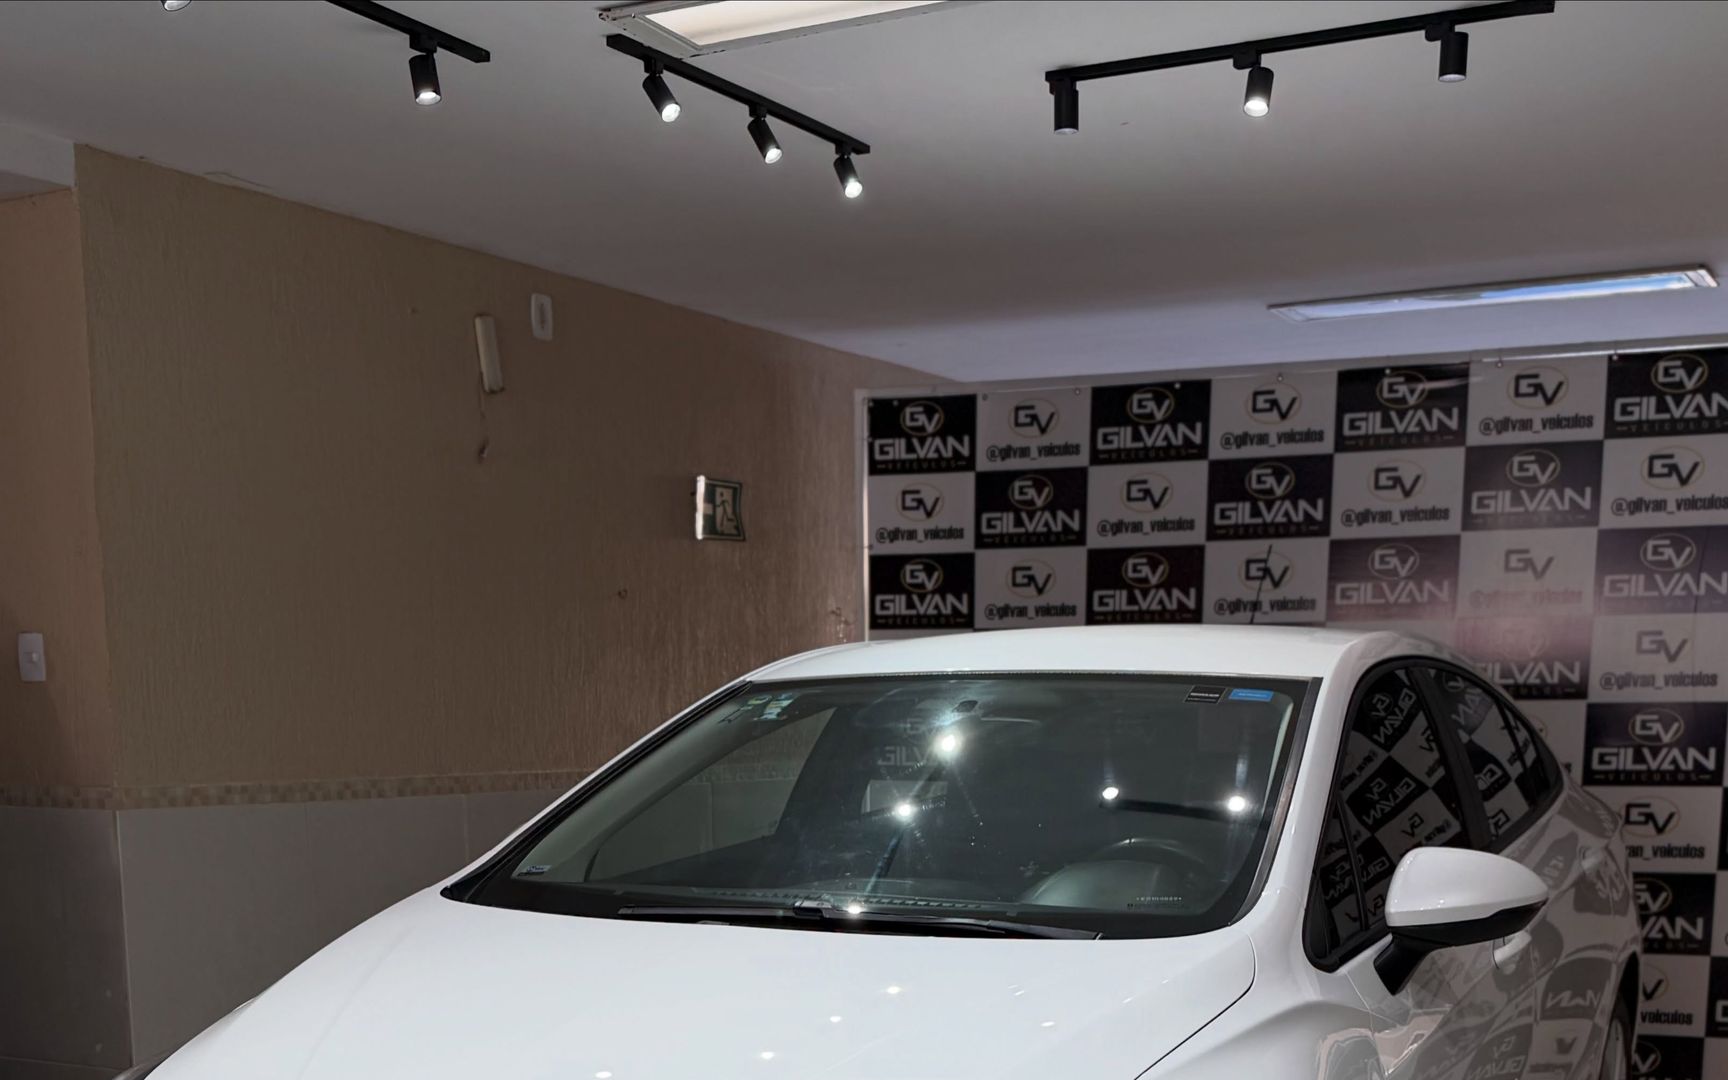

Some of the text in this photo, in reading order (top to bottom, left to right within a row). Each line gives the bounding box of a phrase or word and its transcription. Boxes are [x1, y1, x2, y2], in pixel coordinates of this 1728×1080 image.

[1514, 373, 1565, 406] GV
[1658, 361, 1705, 390] GV
[1252, 389, 1298, 420] GV
[1382, 377, 1424, 404] GV
[906, 406, 940, 432] GV
[1014, 404, 1056, 434] GV
[1132, 393, 1171, 421] GV
[1096, 421, 1203, 449] GILVAN
[1342, 406, 1459, 437] GILVAN
[874, 435, 970, 460] GILVAN
[1251, 468, 1291, 497] GV
[1374, 466, 1422, 498] GV
[1512, 455, 1556, 485] GV
[1648, 454, 1699, 486] GV
[901, 489, 941, 518] GV
[1014, 480, 1050, 507] GV
[1126, 479, 1170, 510] GV
[1471, 486, 1592, 515] GILVAN
[980, 509, 1081, 534] GILVAN
[1213, 498, 1324, 526] GILVAN
[1374, 550, 1415, 577] GV
[1504, 549, 1556, 581] GV
[1647, 540, 1692, 568] GV
[906, 564, 940, 590] GV
[1011, 566, 1053, 595] GV
[1128, 557, 1165, 585] GV
[1244, 558, 1290, 589] GV
[1602, 571, 1728, 598] GILVAN
[875, 593, 969, 615] GILVAN
[1092, 587, 1197, 612] GILVAN
[1335, 579, 1449, 605] GILVAN
[1635, 630, 1689, 663] GV
[1478, 660, 1581, 684] ILVAN
[1635, 715, 1680, 743] GV
[1591, 746, 1717, 771] GILVAN
[1624, 803, 1676, 835] GV
